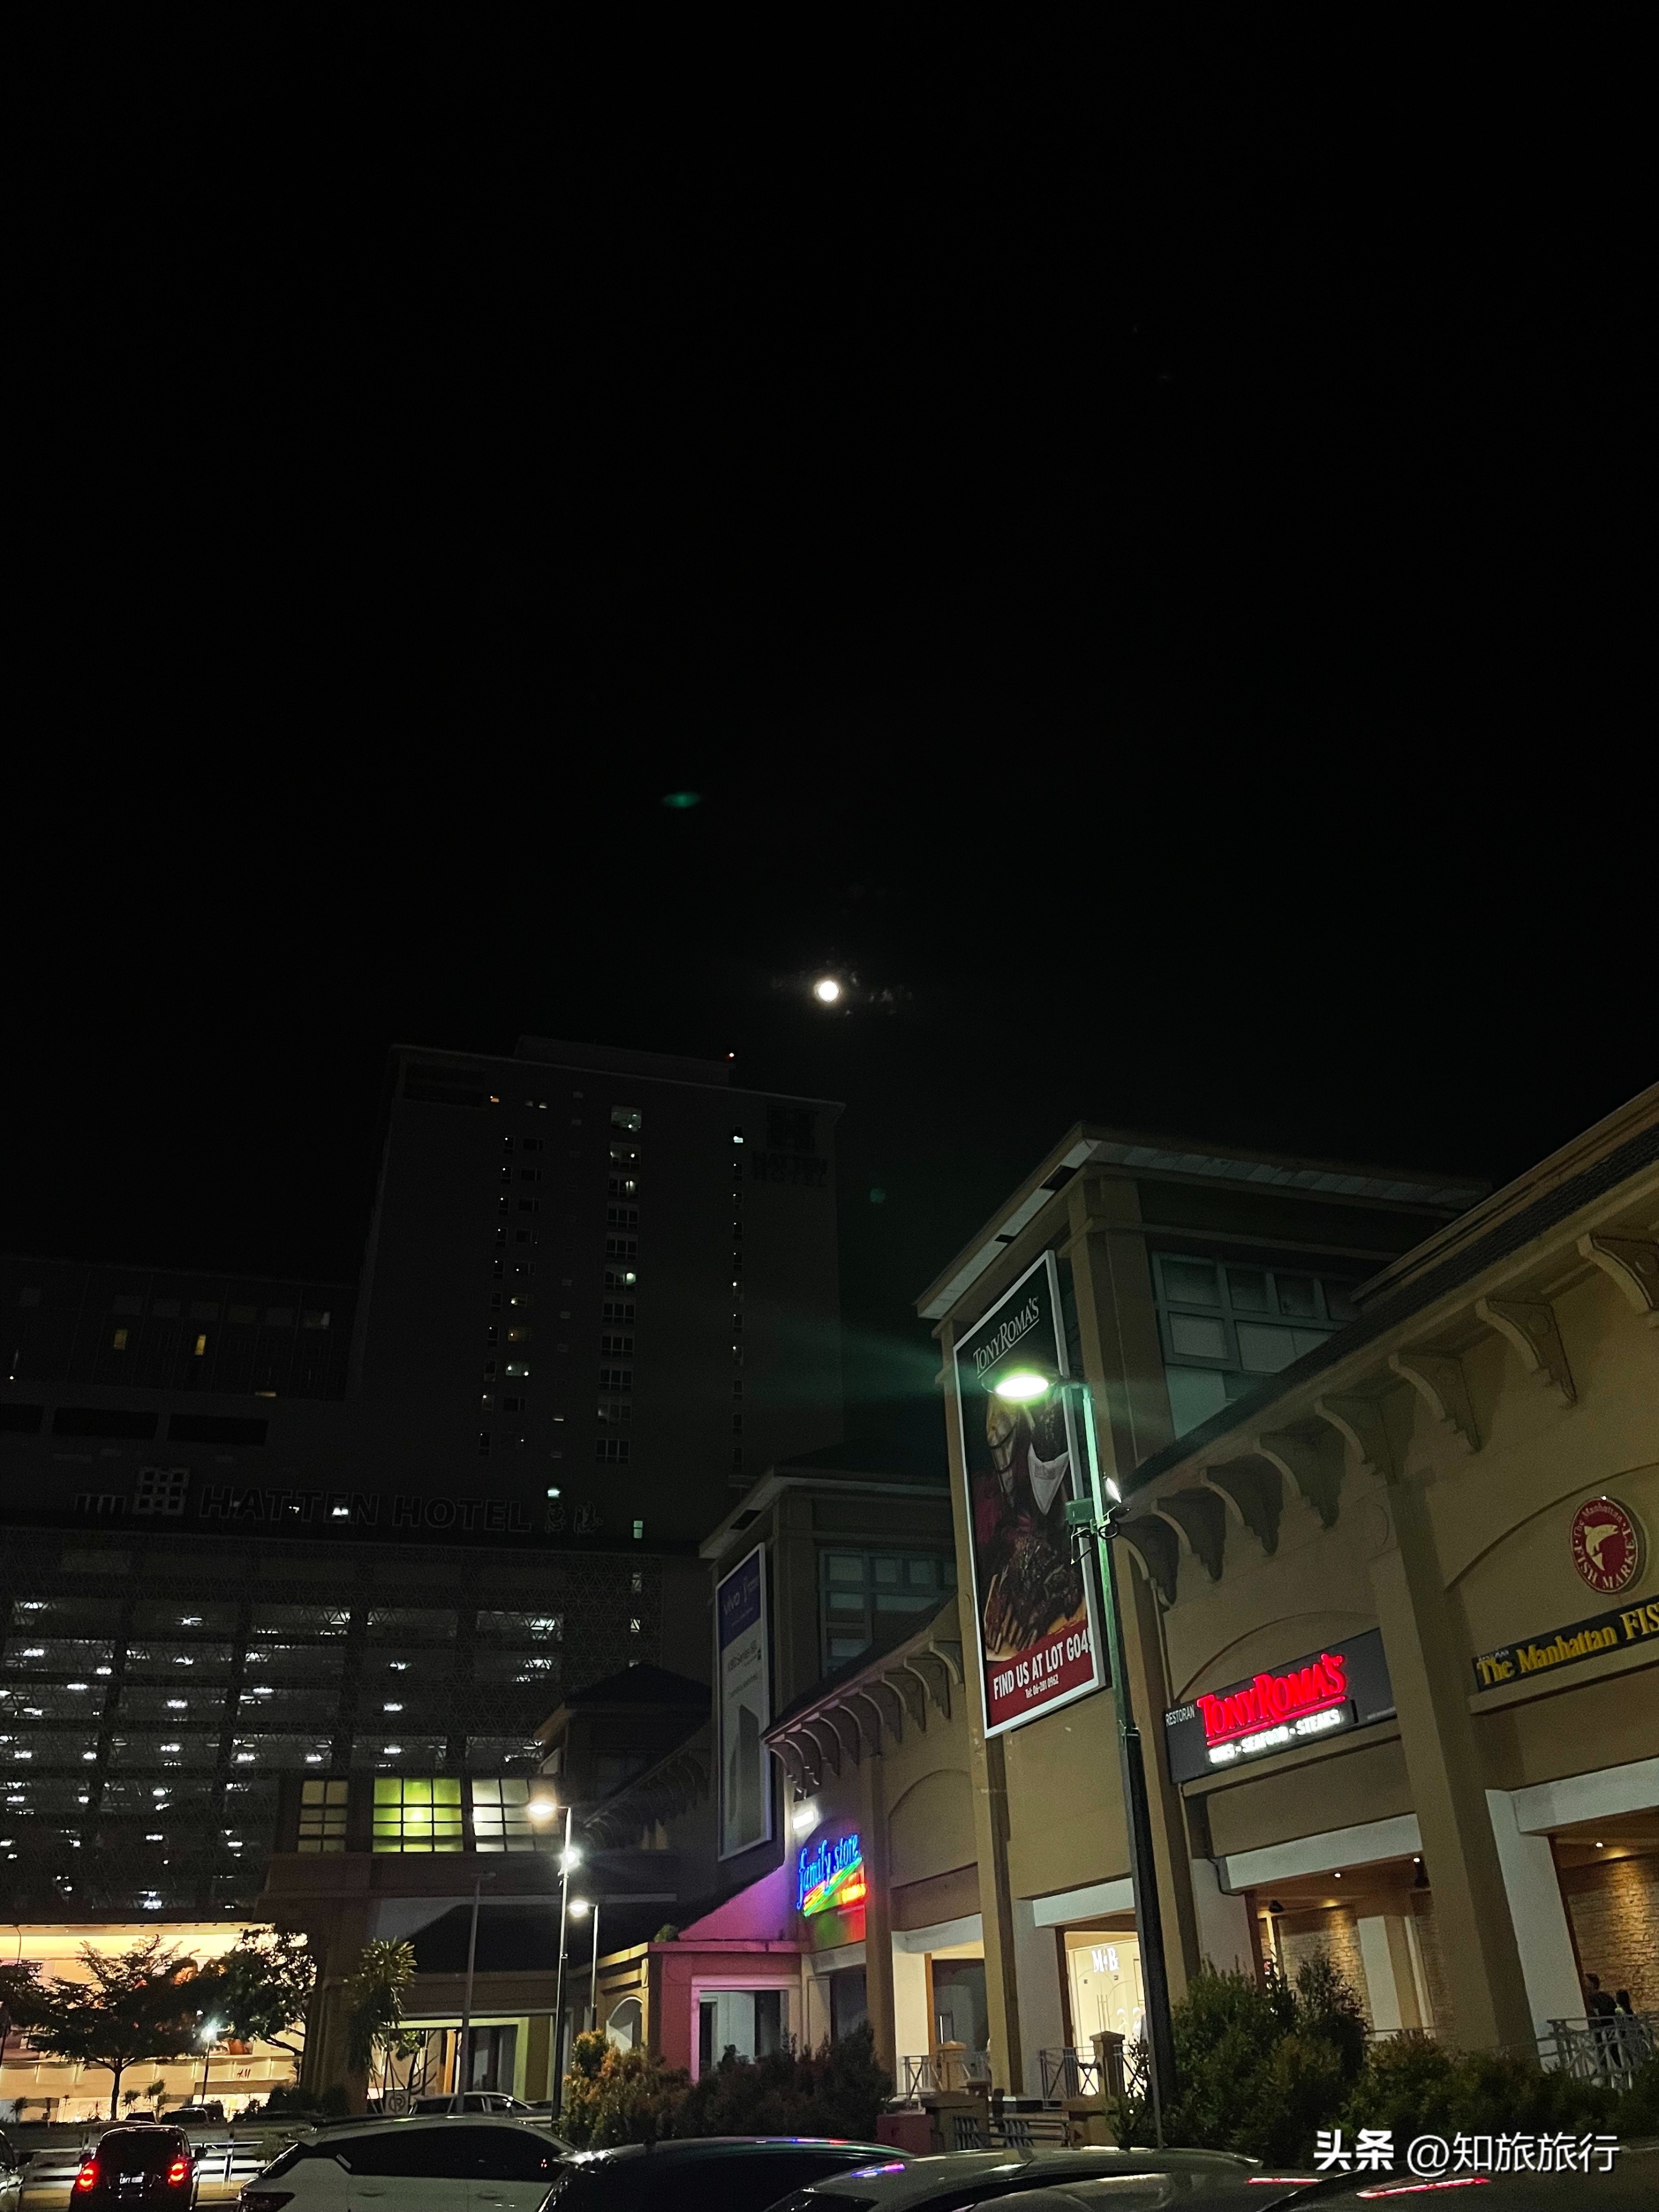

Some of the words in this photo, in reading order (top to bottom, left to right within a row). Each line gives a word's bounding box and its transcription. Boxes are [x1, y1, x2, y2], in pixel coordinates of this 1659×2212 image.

[199, 1485, 380, 1526] HATTEN
[392, 1495, 532, 1533] HOTEL
[1574, 1545, 1599, 1584] FISH
[1602, 1524, 1636, 1589] MARKET
[1476, 1656, 1515, 1686] The
[1516, 1626, 1618, 1673] Manhattan
[1619, 1601, 1659, 1640] FIS
[993, 1670, 1015, 1700] FIND
[1016, 1661, 1029, 1688] US
[1032, 1653, 1043, 1681] AT
[1045, 1642, 1063, 1673] LOT
[1166, 1704, 1195, 1726] RESTORAN
[1295, 1708, 1341, 1735] STEAKS
